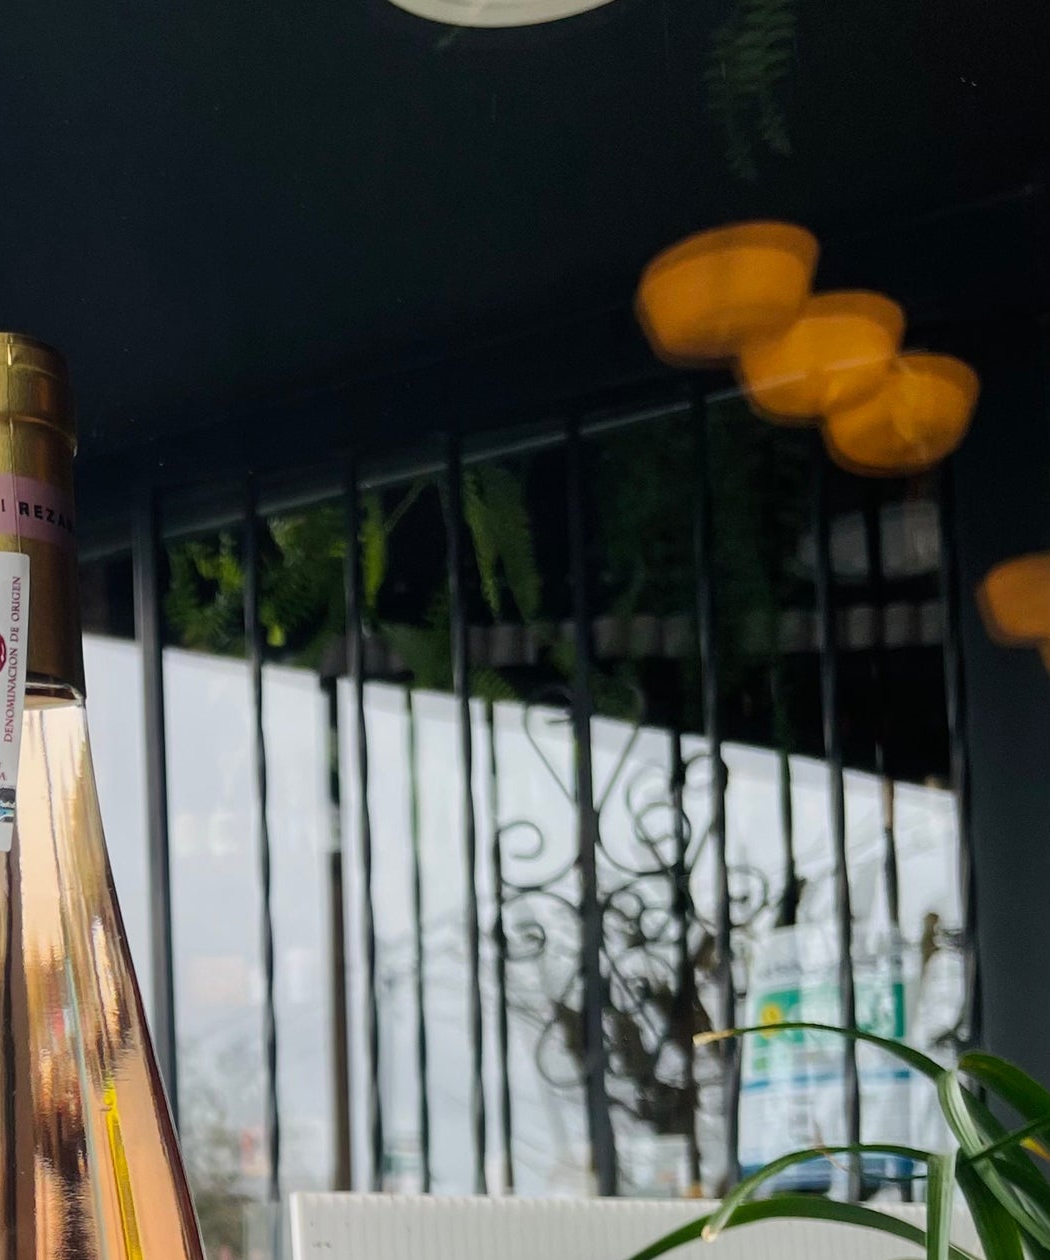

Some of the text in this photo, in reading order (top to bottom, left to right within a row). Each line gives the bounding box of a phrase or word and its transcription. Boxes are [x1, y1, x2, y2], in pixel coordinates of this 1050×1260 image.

[3, 576, 22, 743] DENOMINACION DE ORIGEN
